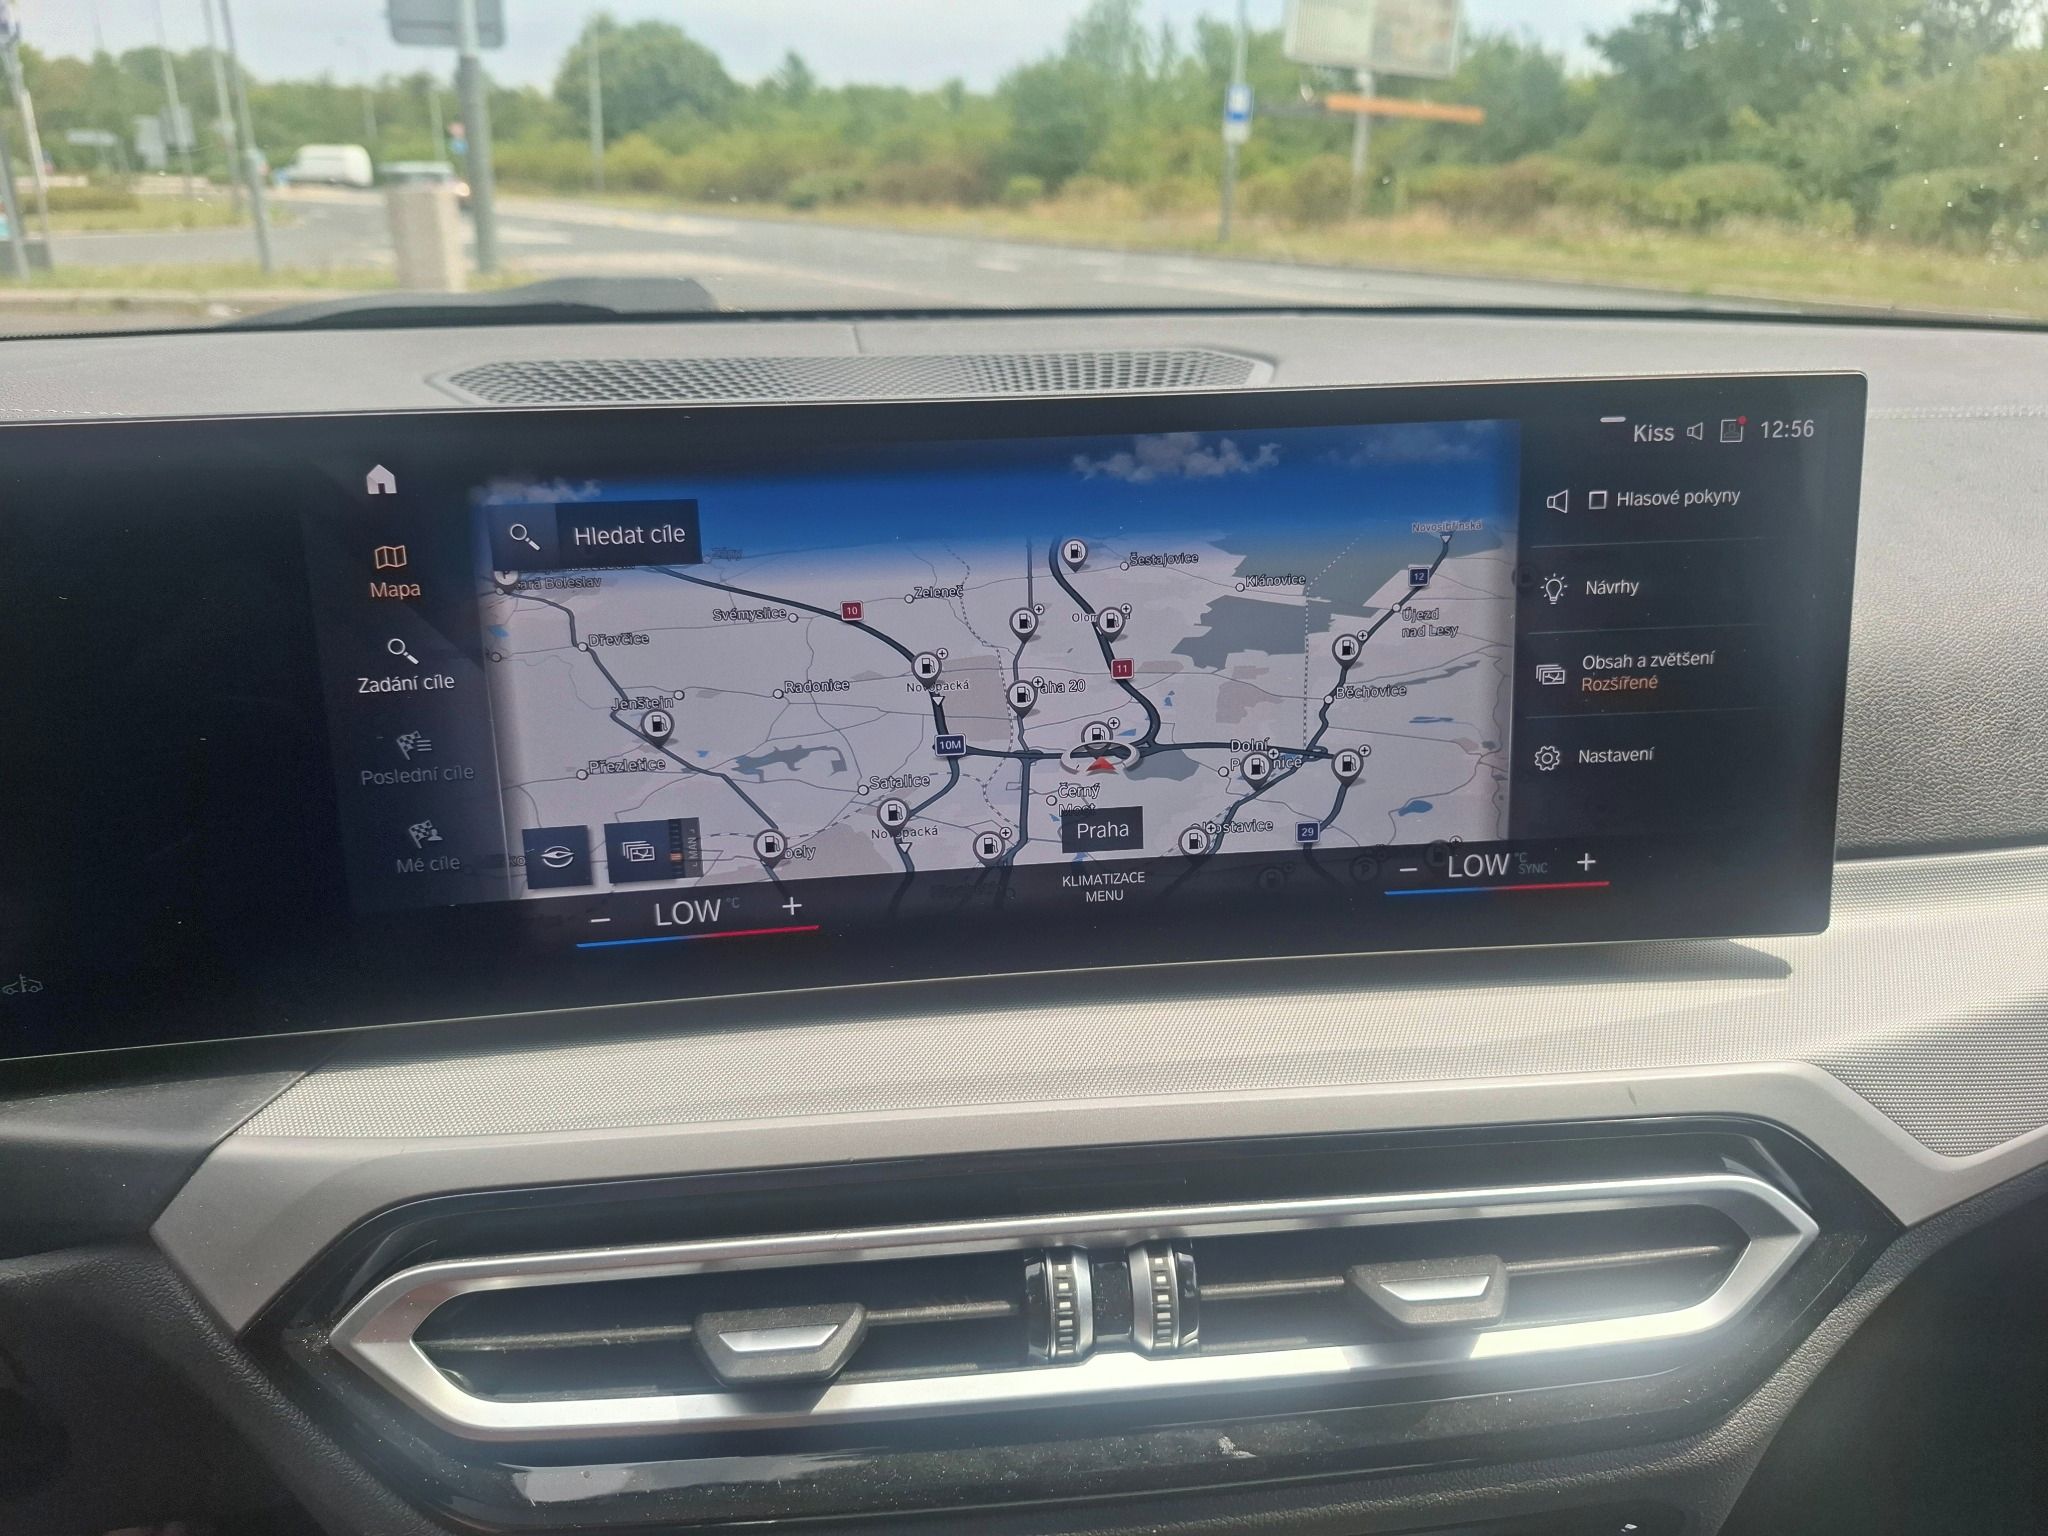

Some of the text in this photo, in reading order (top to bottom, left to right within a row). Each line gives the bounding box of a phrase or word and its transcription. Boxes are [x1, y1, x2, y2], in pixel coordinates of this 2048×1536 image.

[1634, 424, 1675, 442] Kiss
[1760, 419, 1815, 439] 12:56
[1616, 489, 1741, 507] Hlasové pokyny
[574, 523, 686, 546] Hledat cíle
[1129, 552, 1199, 567] Šestajovice
[545, 576, 602, 590] Boleslav
[1245, 573, 1307, 588] Klánovice
[1414, 572, 1425, 581] 12
[370, 581, 422, 600] Mapa
[913, 584, 964, 599] Zeleneč
[1585, 579, 1640, 597] Návrhy
[712, 606, 787, 622] Svémyslice
[846, 605, 858, 616] 10
[1401, 606, 1440, 623] Újezd
[588, 632, 650, 647] Dřevčice
[1401, 625, 1459, 638] nad Lesy
[1582, 650, 1716, 670] Obsah a zvětšení
[1117, 664, 1128, 673] 11
[358, 673, 456, 694] Zadání cíle
[784, 679, 850, 694] Radonice
[1069, 679, 1086, 693] 20
[1581, 675, 1658, 692] Rozšířené
[1336, 684, 1407, 700] Běchovice
[611, 696, 674, 711] Jenštejn
[938, 739, 962, 750] 10M
[1231, 737, 1270, 753] Dolní
[1578, 746, 1656, 763] Nastavení
[588, 757, 666, 774] Přezletice
[362, 764, 474, 786] Poslední cíle
[869, 774, 930, 790] Satalice
[1058, 782, 1101, 799] Černý
[1077, 821, 1129, 839] Praha
[1301, 827, 1314, 838] 29
[397, 855, 461, 873] Mé cíle
[1448, 853, 1510, 878] LOW
[1062, 872, 1146, 887] KLIMATIZACE
[1086, 889, 1124, 903] MENU
[654, 898, 721, 926] LOW
